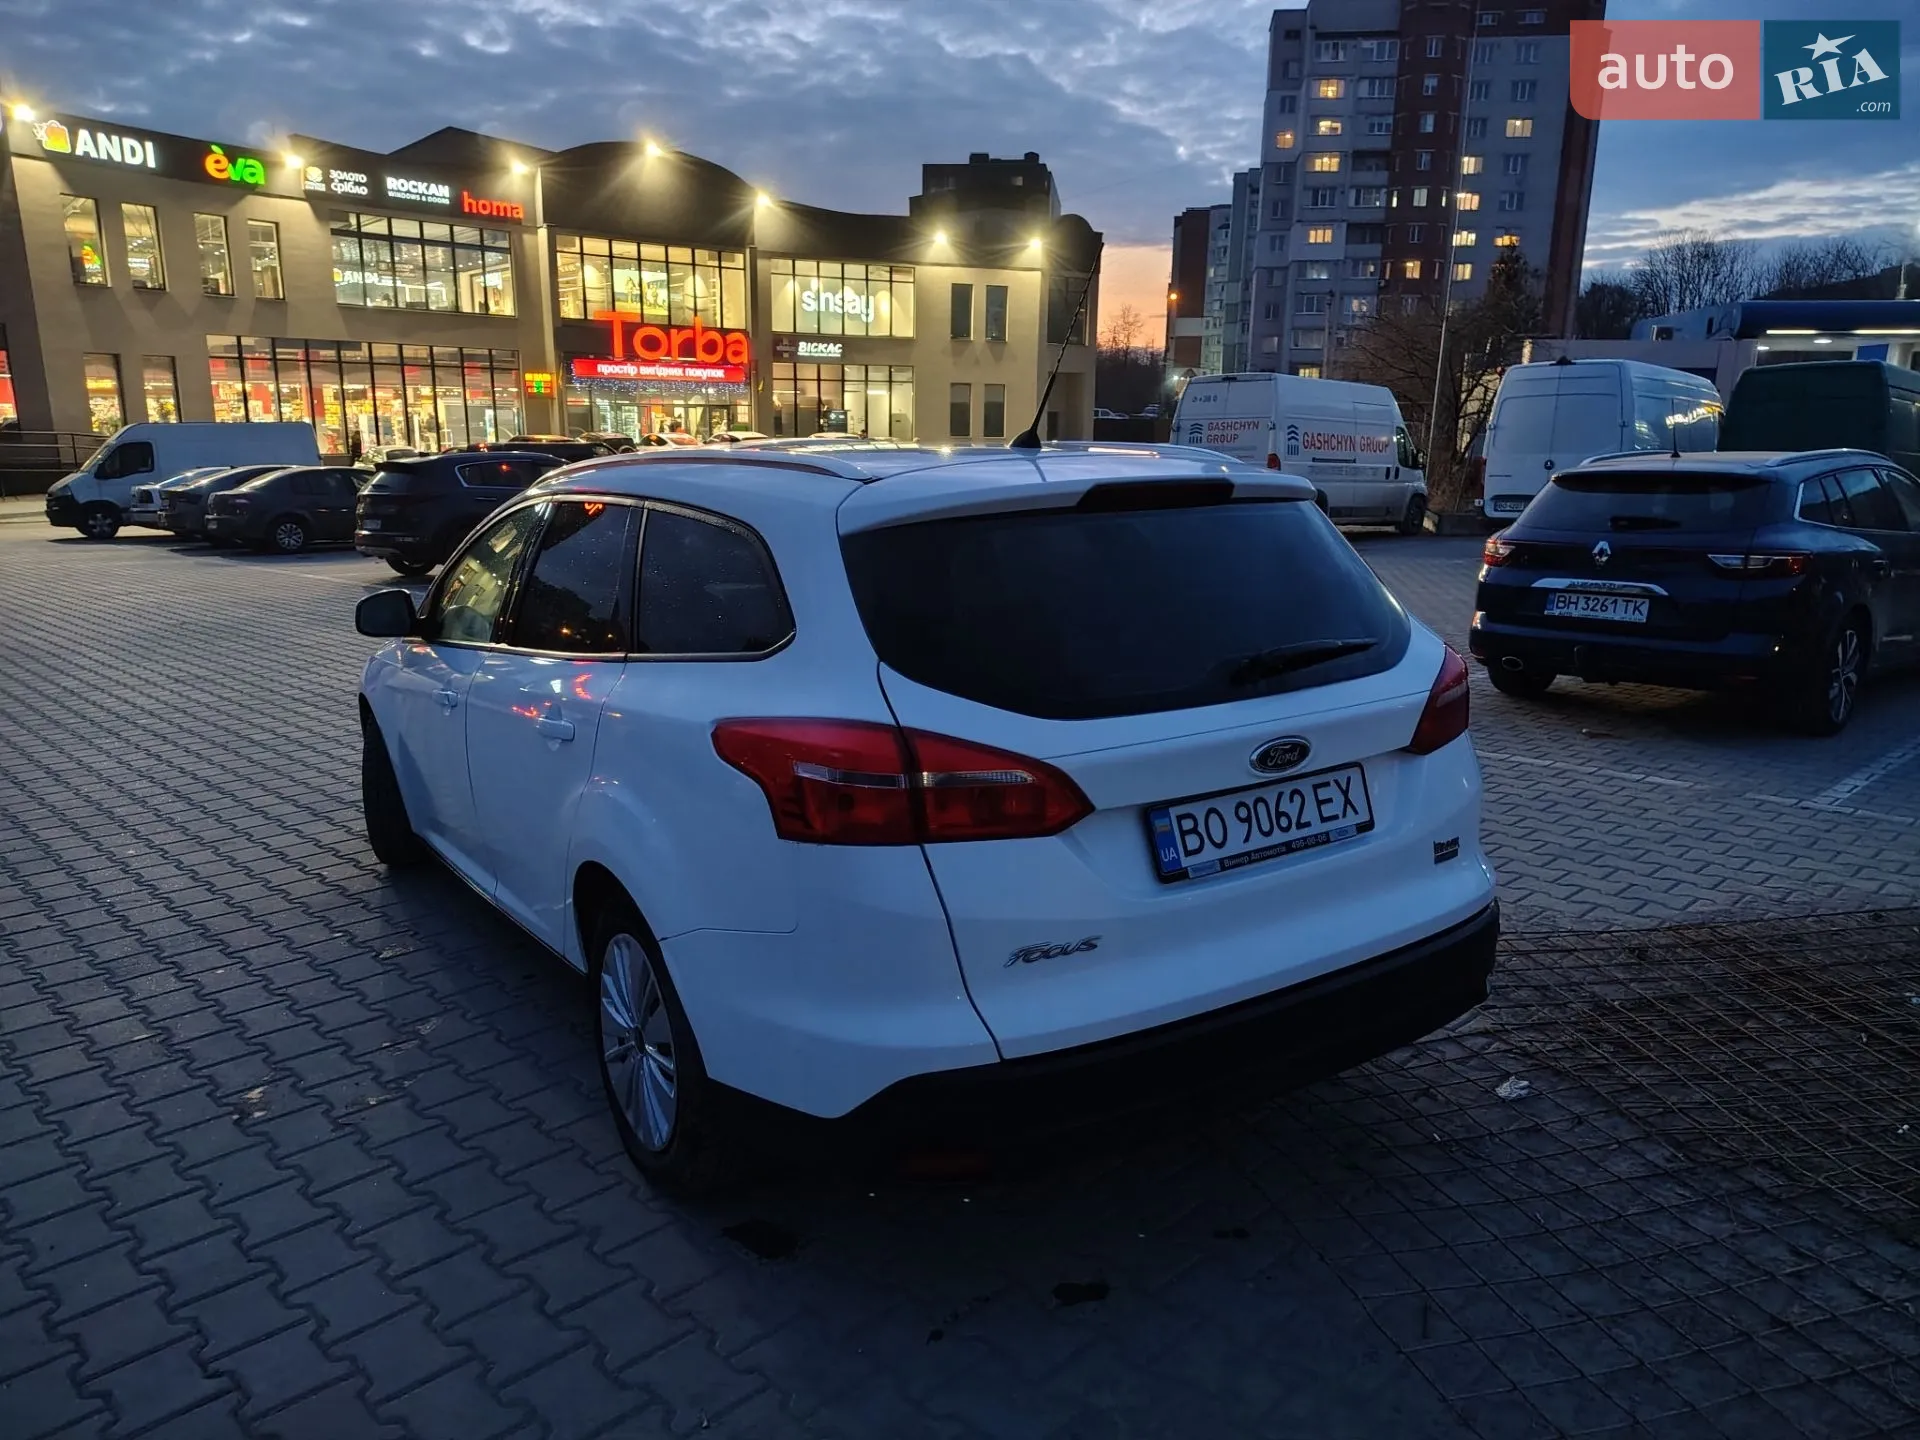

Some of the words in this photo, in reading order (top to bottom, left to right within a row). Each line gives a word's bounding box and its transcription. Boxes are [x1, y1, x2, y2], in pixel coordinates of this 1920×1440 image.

[75, 129, 156, 168] ANDI
[386, 176, 450, 198] ROCKAN
[462, 190, 524, 220] homa
[593, 310, 749, 364] Torba
[1207, 420, 1260, 431] GASHCHYN
[1206, 433, 1239, 444] GROUP
[1302, 431, 1356, 452] GASHCHYN
[1359, 437, 1390, 454] GROUP
[1581, 596, 1618, 614] 3261
[1266, 745, 1300, 767] Ford
[1161, 846, 1178, 862] UA
